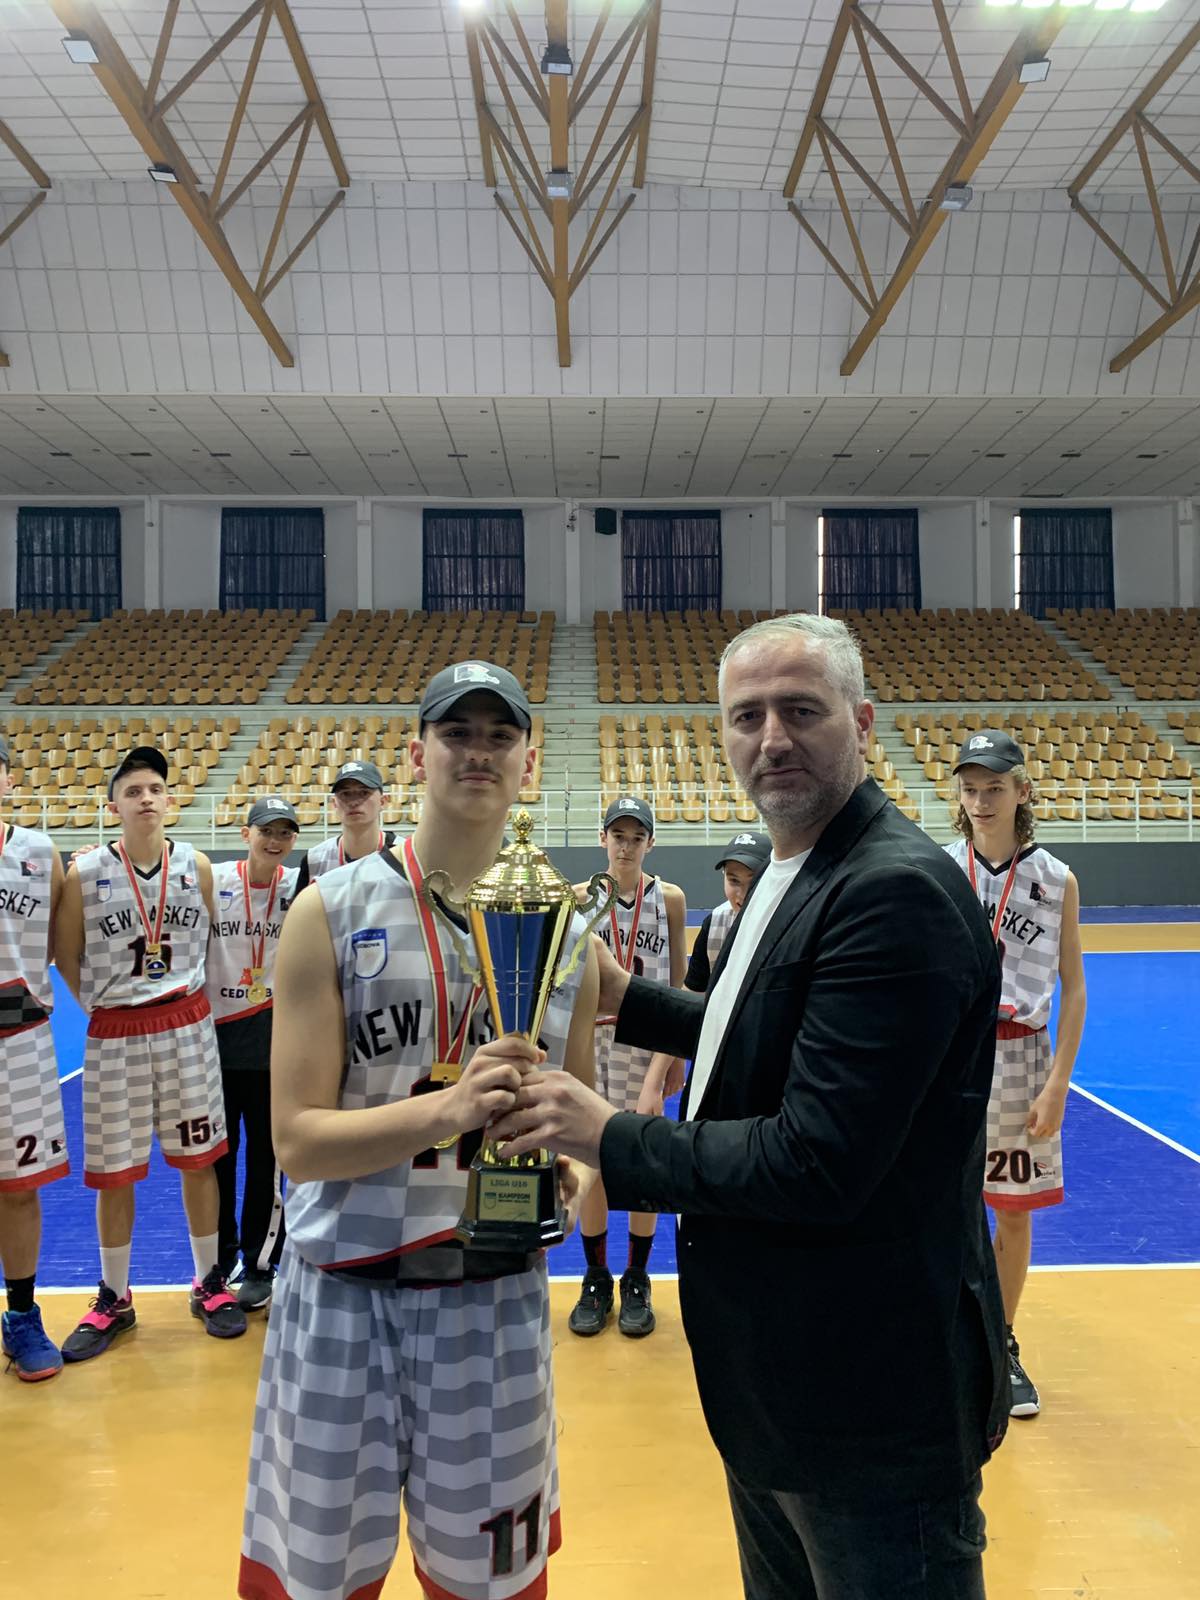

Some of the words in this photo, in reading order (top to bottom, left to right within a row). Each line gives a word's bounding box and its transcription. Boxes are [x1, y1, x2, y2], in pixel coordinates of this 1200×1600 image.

[99, 908, 132, 940] NEW
[139, 904, 201, 929] ASKET
[211, 920, 241, 938] NEW
[983, 900, 1046, 946] ASKET
[352, 999, 422, 1065] NEW
[176, 1115, 210, 1148] 15
[16, 1134, 38, 1168] 2
[986, 1149, 1032, 1184] 20
[479, 1490, 542, 1578] 11
